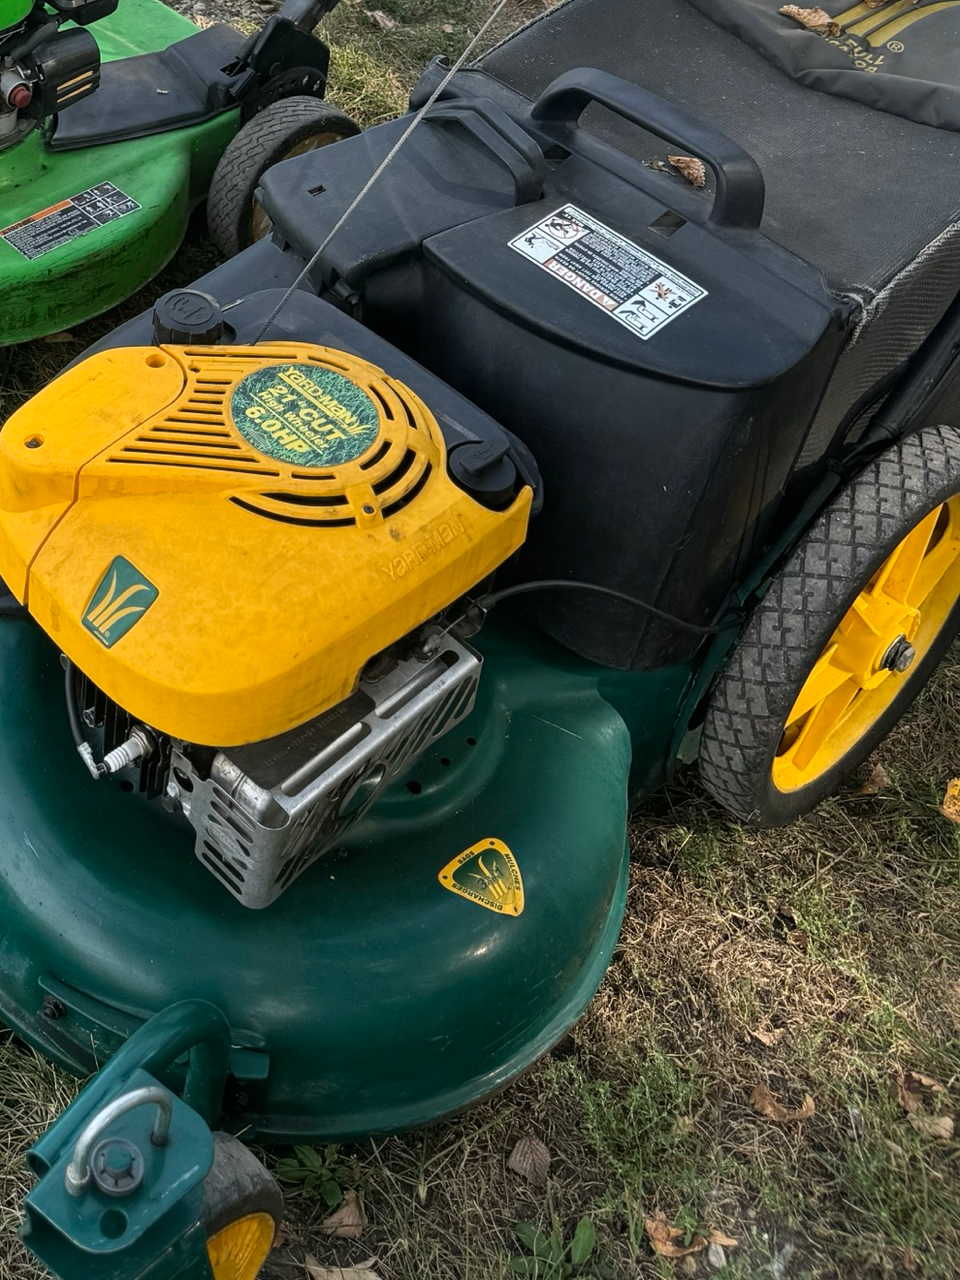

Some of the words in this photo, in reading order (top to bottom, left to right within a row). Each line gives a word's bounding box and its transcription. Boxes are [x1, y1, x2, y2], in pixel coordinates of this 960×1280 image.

[546, 260, 603, 299] DANGER
[244, 406, 310, 454] 6.0HP
[257, 390, 285, 414] High
[283, 411, 331, 451] Wheeler
[297, 407, 347, 442] CUT
[456, 849, 475, 864] BAGS
[503, 852, 520, 891] MULCHES
[451, 882, 503, 911] DISCHARGES
